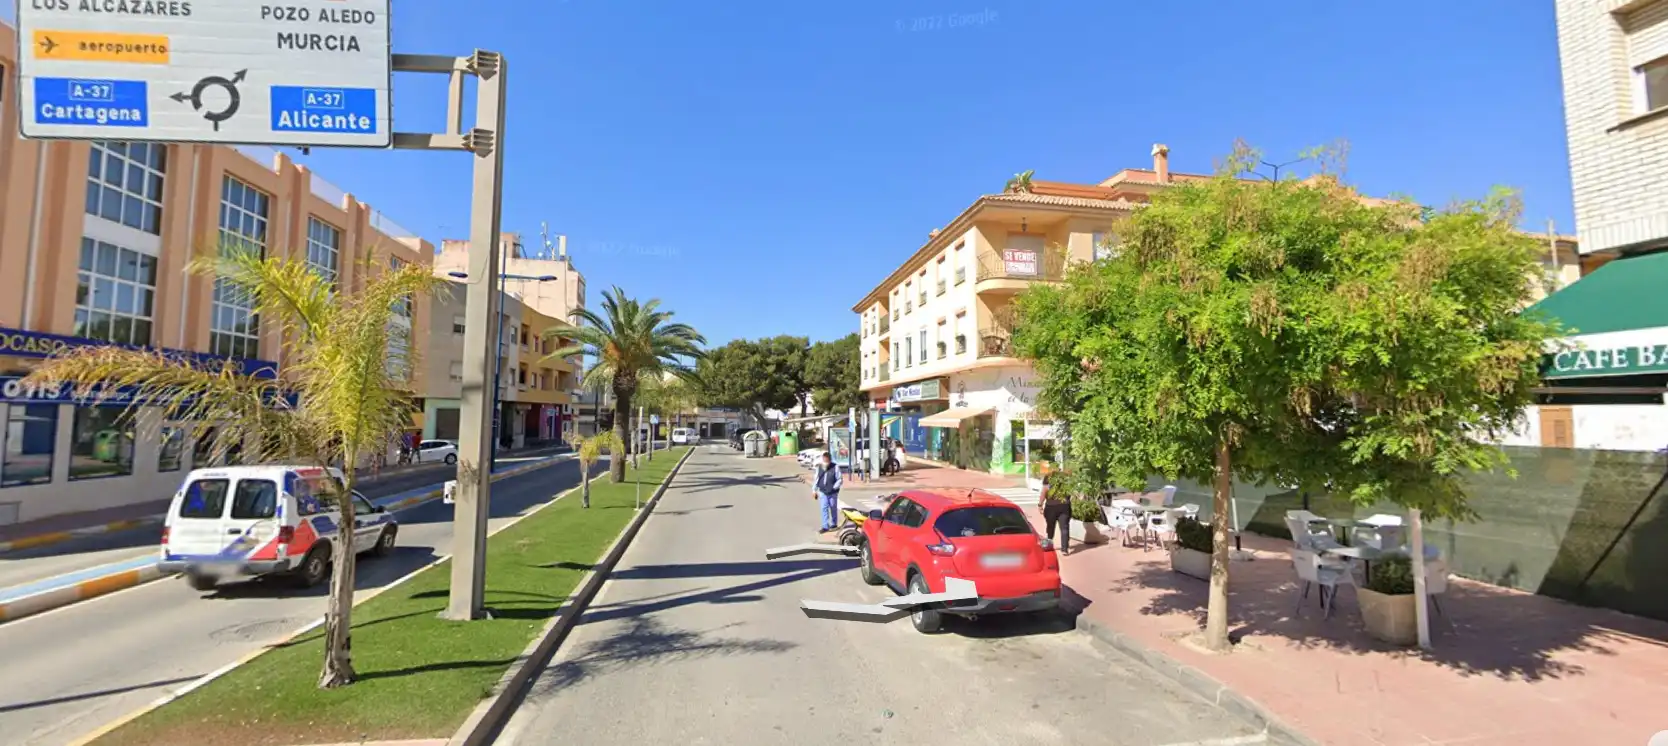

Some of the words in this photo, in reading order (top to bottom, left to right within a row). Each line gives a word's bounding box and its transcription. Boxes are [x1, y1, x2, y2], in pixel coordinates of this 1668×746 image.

[32, 0, 69, 11] LOS
[79, 0, 192, 16] ALCAZARES
[261, 5, 310, 21] POZO
[318, 8, 375, 24] ALEDO
[79, 40, 168, 54] aeropuerto
[277, 32, 361, 52] MURCIA
[74, 84, 112, 99] A-37
[306, 91, 342, 107] A-37
[41, 103, 141, 125] Cartagena
[277, 109, 371, 130] Alicante
[1554, 347, 1629, 372] CAFE
